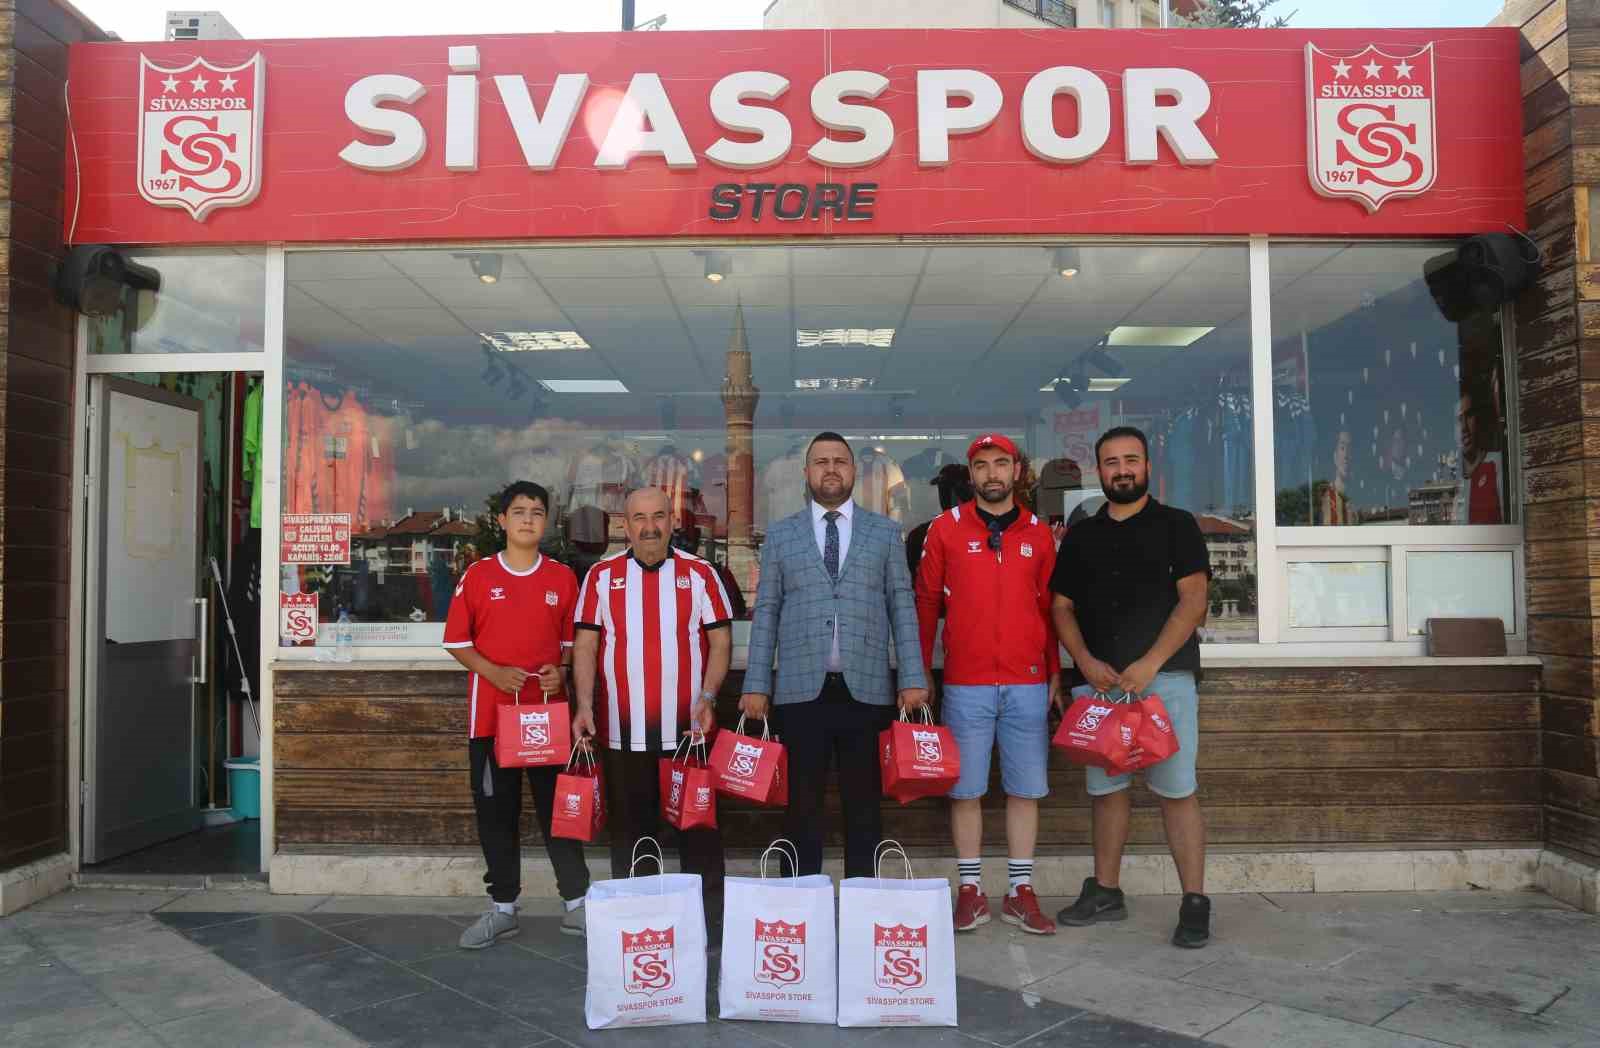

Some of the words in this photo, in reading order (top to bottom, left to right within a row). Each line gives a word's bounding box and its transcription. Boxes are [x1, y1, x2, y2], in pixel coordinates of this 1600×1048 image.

[1325, 170, 1355, 184] 1967
[148, 177, 177, 192] 1967
[708, 182, 878, 222] STORE
[659, 995, 684, 1006] STORE
[788, 992, 812, 1001] STORE
[910, 997, 935, 1006] STORE
